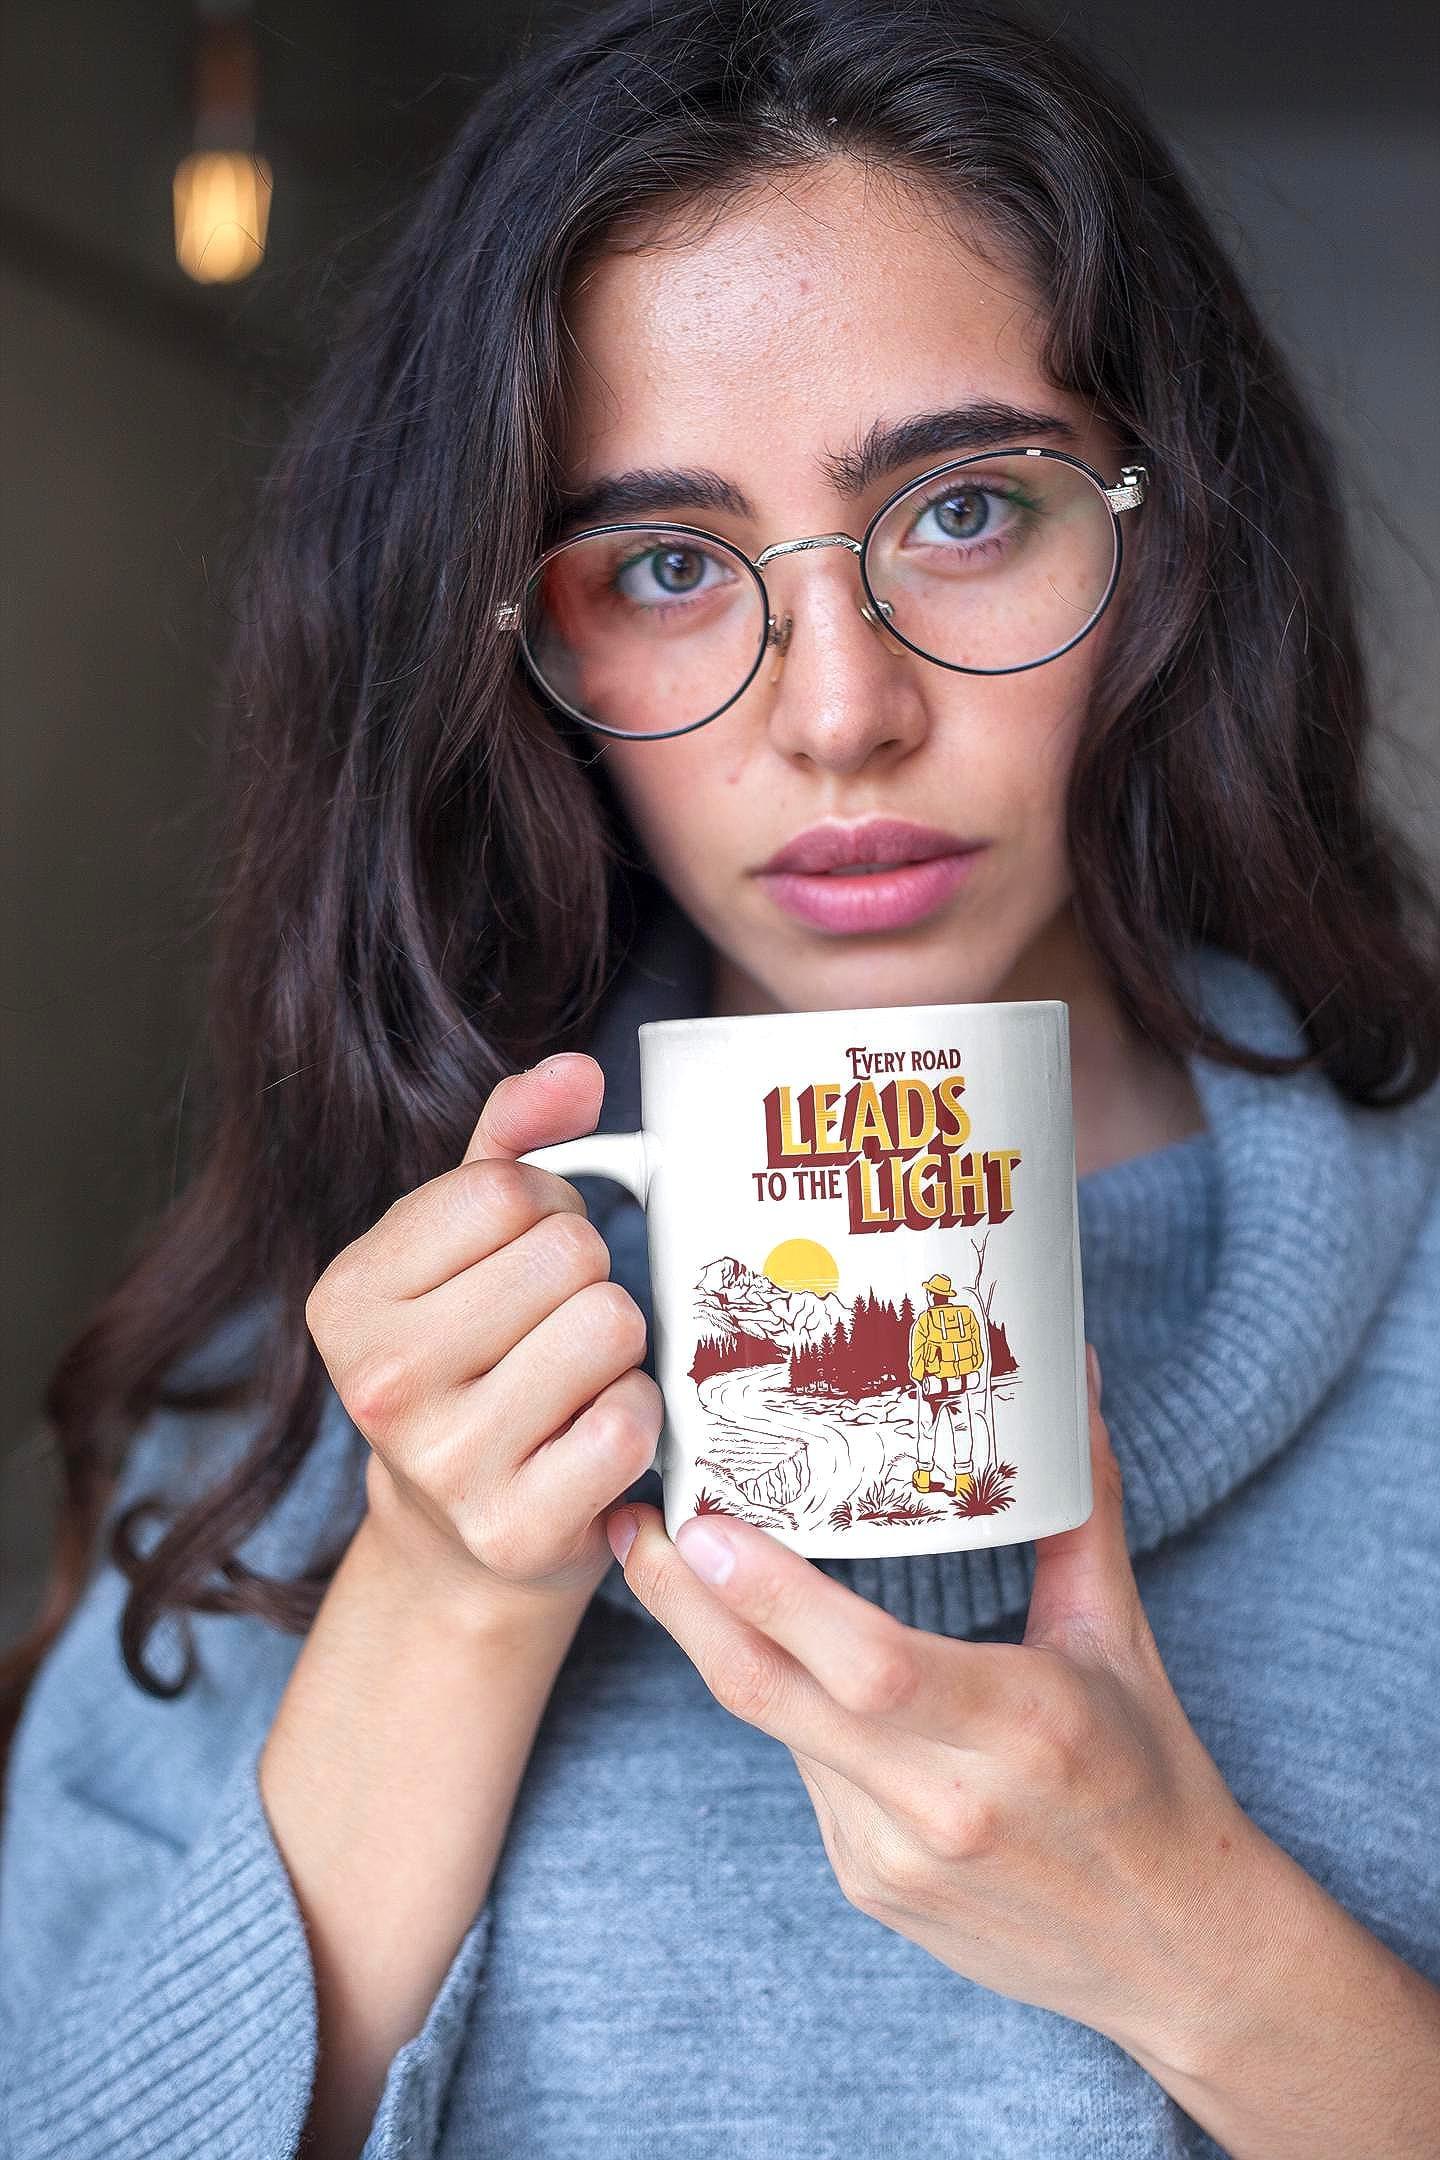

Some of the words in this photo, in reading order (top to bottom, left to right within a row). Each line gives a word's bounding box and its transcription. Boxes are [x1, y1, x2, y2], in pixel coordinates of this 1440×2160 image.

[845, 1046, 905, 1079] EVERY
[911, 1048, 961, 1072] ROAD
[763, 1076, 972, 1169] LEADS
[752, 1172, 787, 1202] TO
[793, 1170, 842, 1201] THE
[845, 1149, 1022, 1235] LIGHT
